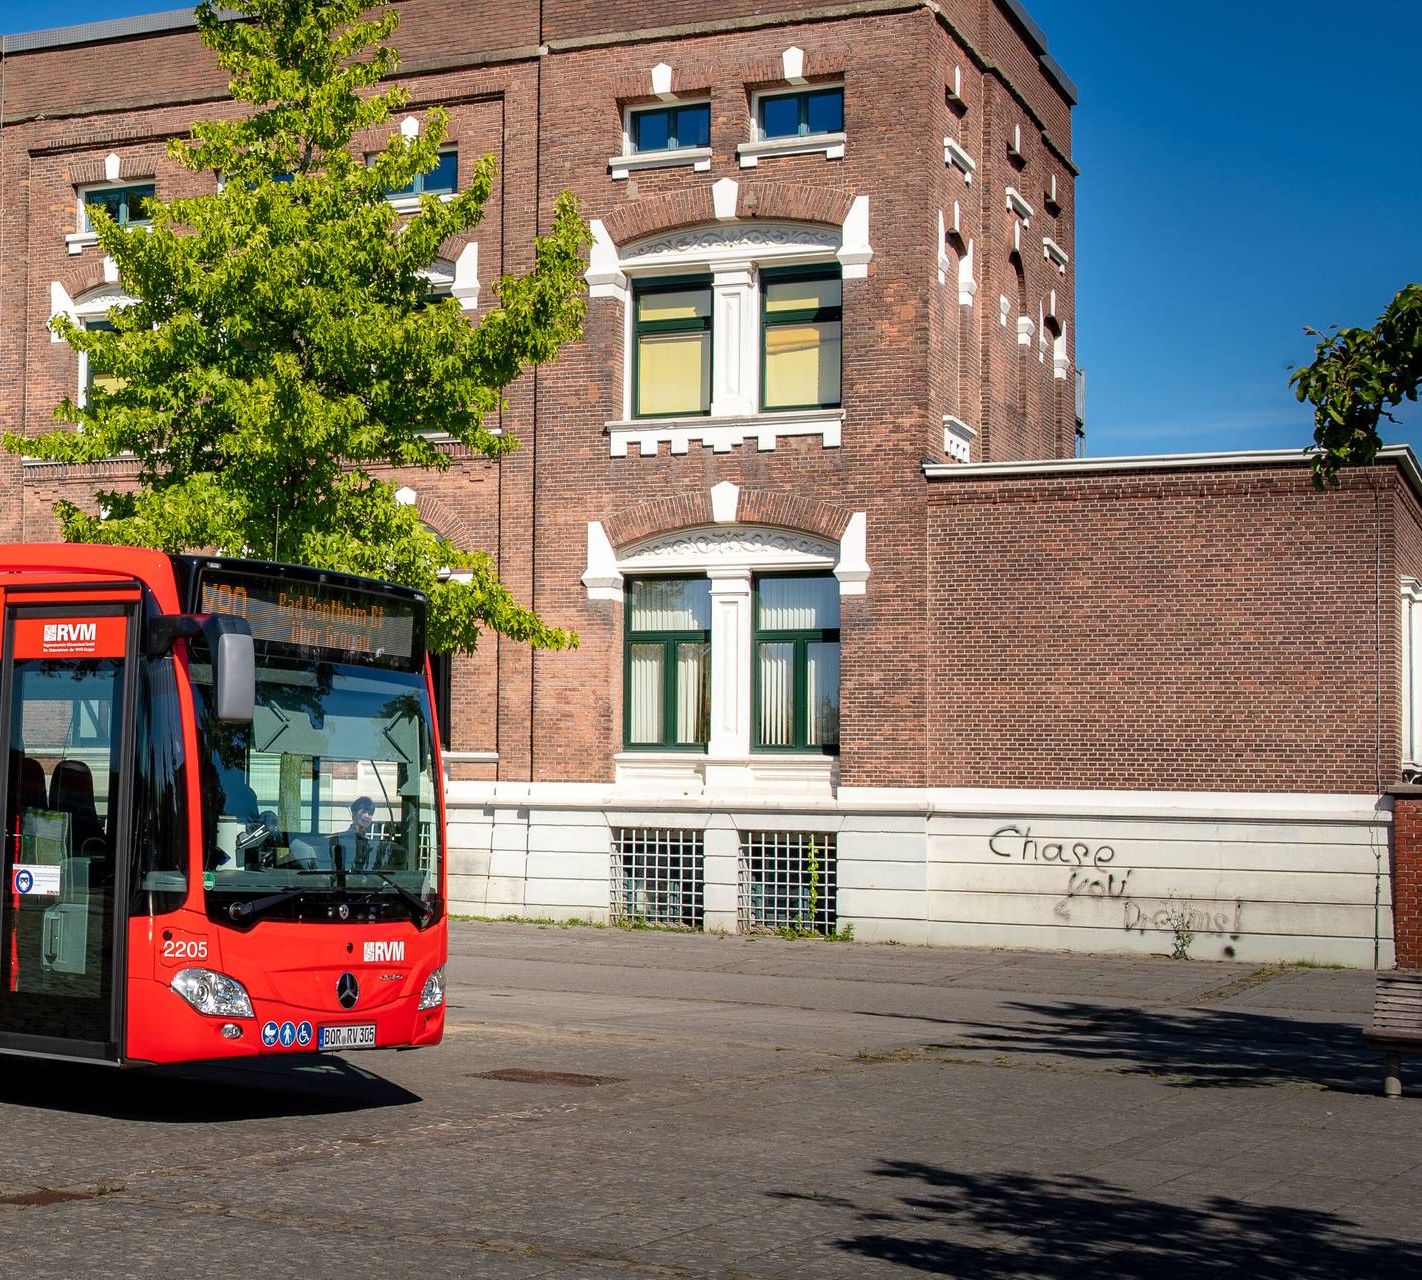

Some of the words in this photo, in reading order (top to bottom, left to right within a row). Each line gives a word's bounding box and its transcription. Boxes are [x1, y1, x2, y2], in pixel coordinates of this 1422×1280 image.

[57, 623, 97, 641] RVM
[989, 825, 1115, 872] Chase
[163, 941, 208, 958] 2205
[375, 941, 405, 962] RVM
[324, 1029, 341, 1045] BOR
[347, 1028, 358, 1044] RV
[359, 1027, 374, 1043] 305
